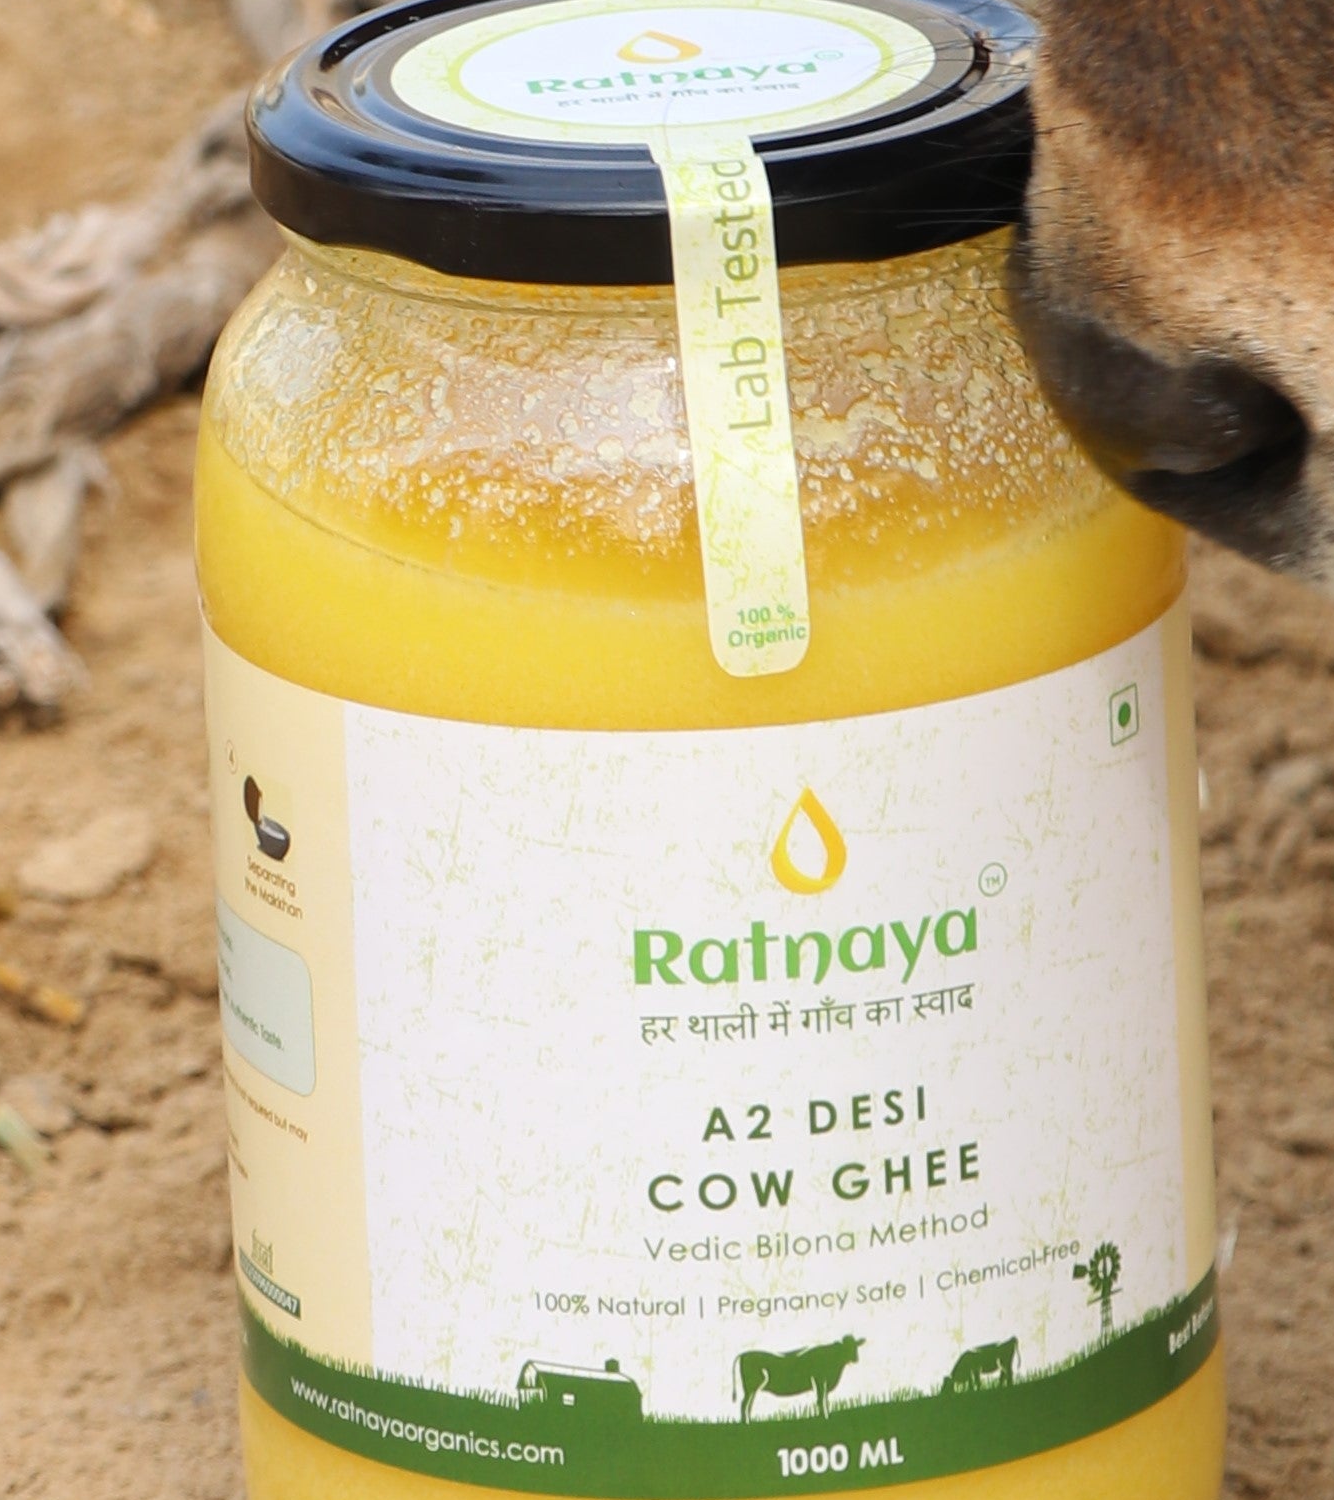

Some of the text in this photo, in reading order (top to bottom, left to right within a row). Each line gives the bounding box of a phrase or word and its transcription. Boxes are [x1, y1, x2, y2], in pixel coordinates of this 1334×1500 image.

[526, 61, 818, 96] Ratnaya
[712, 158, 773, 431] Lab Tested
[728, 623, 807, 649] Organic
[736, 604, 771, 625] 100
[633, 906, 978, 985] Ratnaya
[639, 982, 975, 1046] हर थाली में गाँव का स्वाद
[701, 1084, 926, 1142] A2 DESI
[647, 1141, 980, 1213] COW GHEE
[643, 1202, 990, 1262] Vedic Bilona Method
[533, 1290, 590, 1315] 100%
[597, 1296, 687, 1317] Natural
[717, 1289, 850, 1318] Pregnancy
[289, 1375, 565, 1467] www.ratnayaorganics.com
[776, 1436, 906, 1478] 1000 ML
